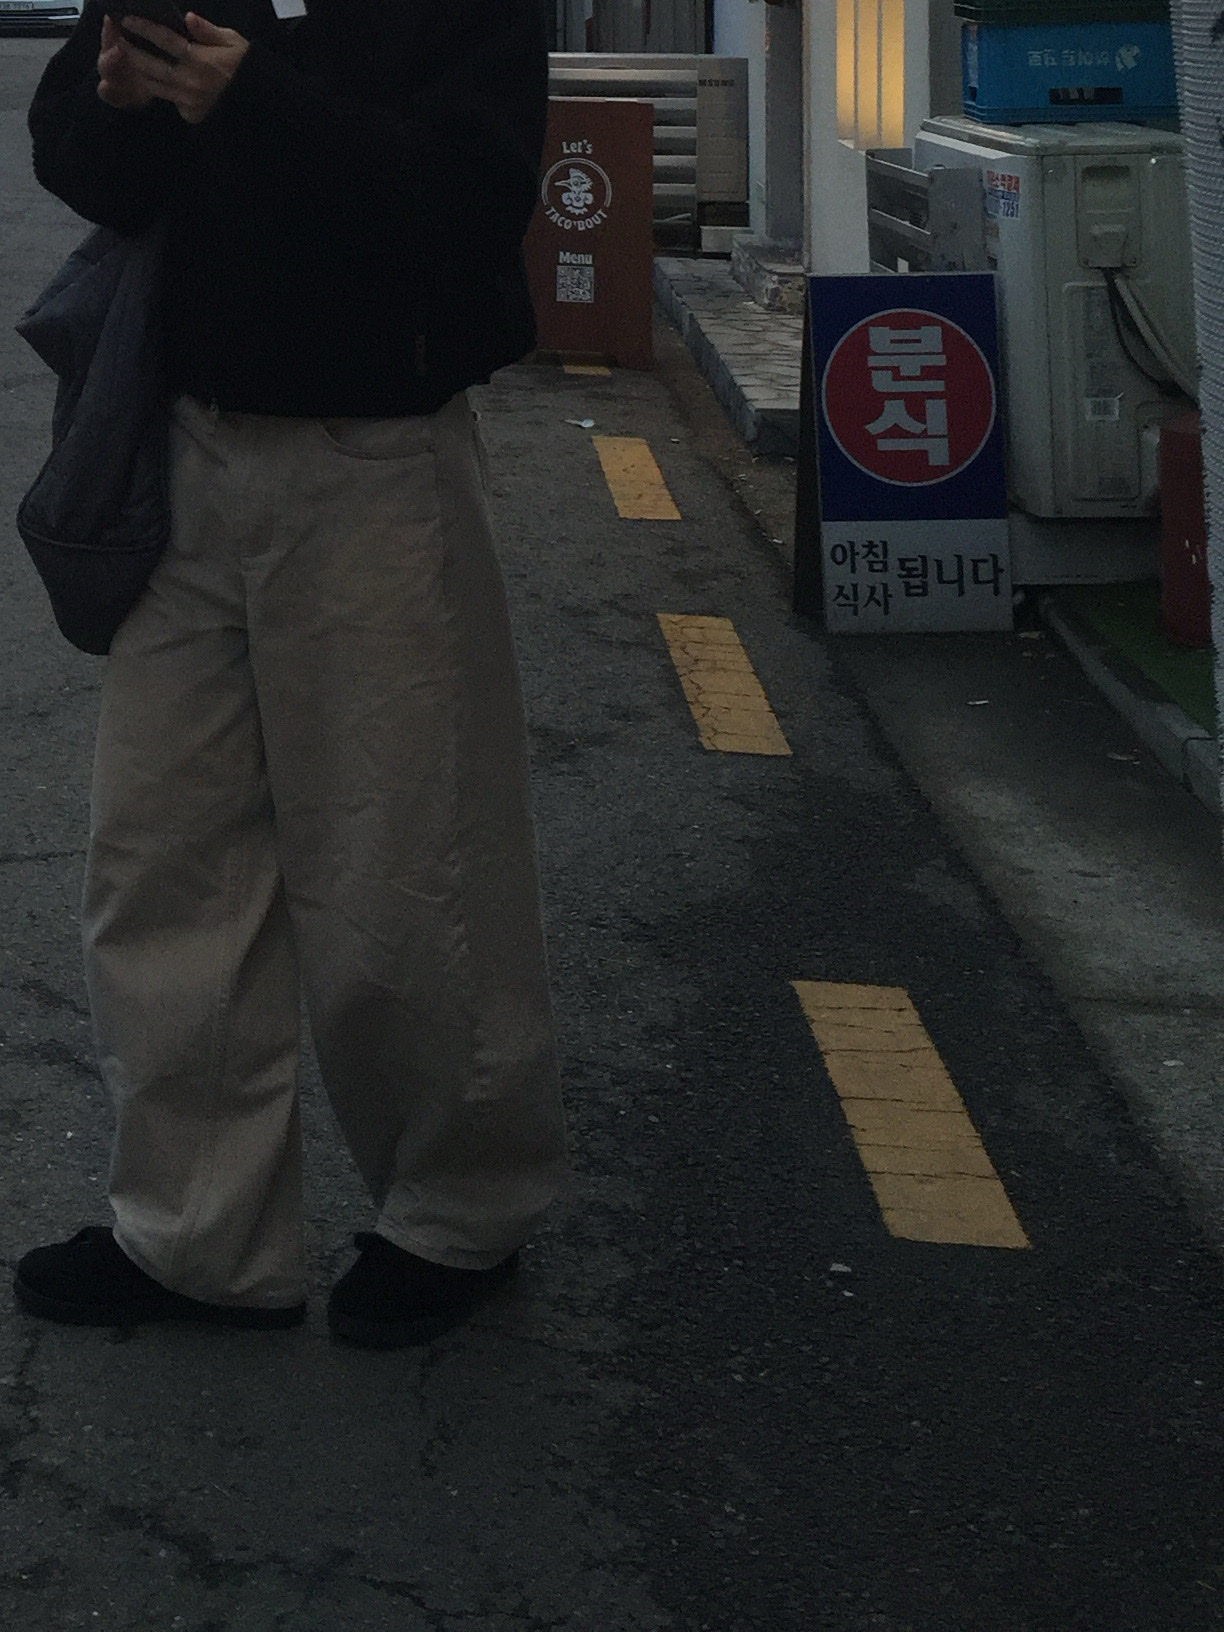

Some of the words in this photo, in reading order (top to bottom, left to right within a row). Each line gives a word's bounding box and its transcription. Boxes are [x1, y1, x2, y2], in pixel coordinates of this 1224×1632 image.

[562, 140, 593, 154] Let's
[545, 207, 608, 231] TACO'BOUT
[559, 251, 593, 265] Menu
[865, 325, 950, 466] 분식
[831, 540, 889, 573] 아침
[898, 553, 1005, 596] 됩니다
[831, 582, 892, 616] 식사
